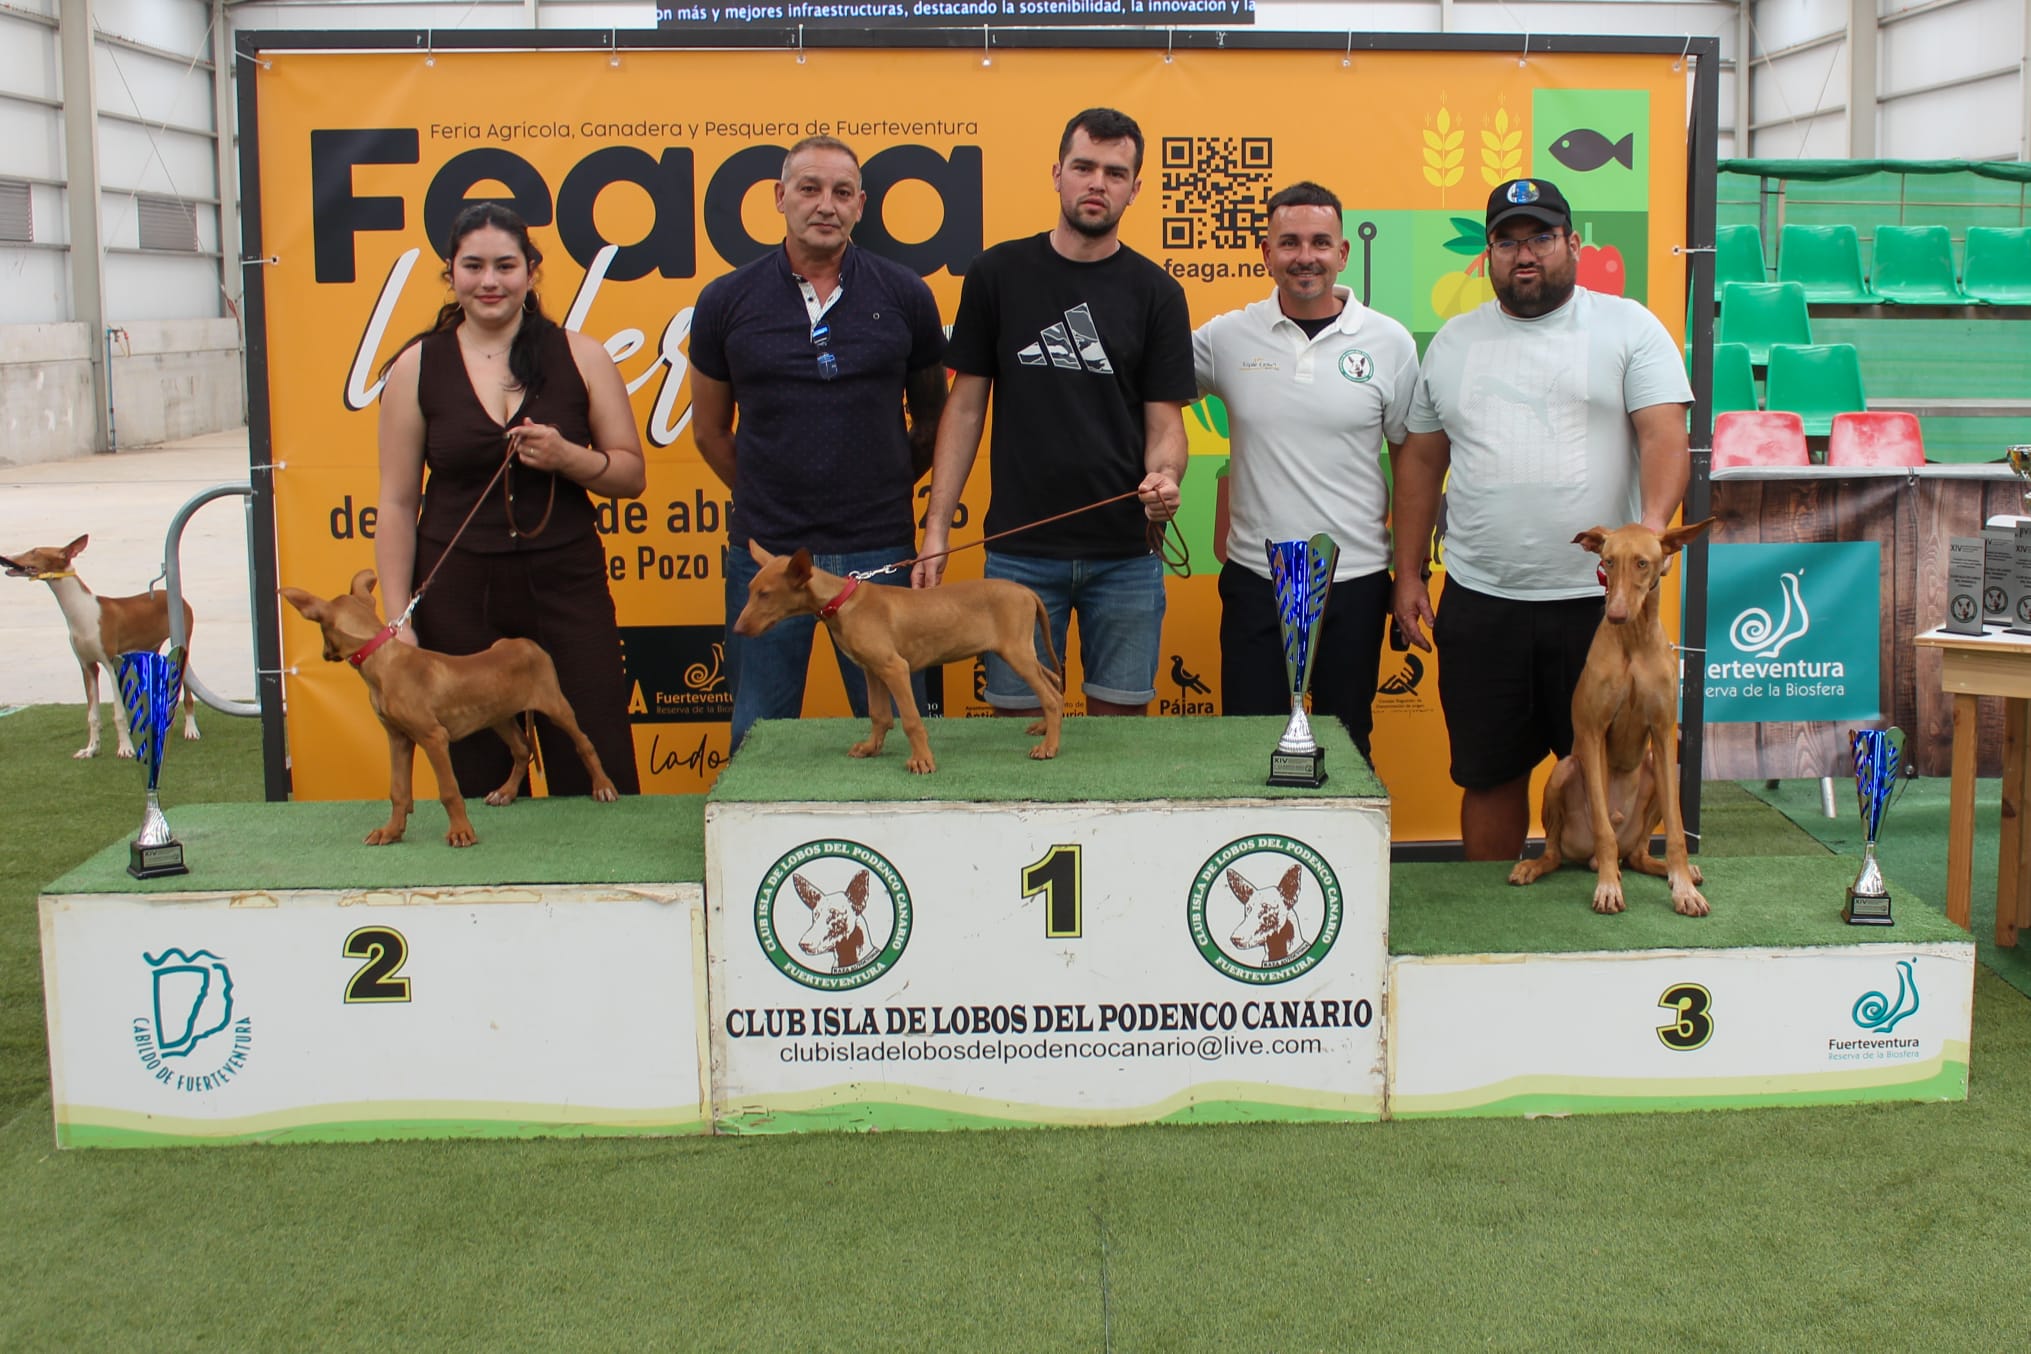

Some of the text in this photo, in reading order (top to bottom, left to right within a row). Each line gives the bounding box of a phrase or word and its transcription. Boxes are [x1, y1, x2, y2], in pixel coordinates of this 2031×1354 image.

[678, 4, 707, 20] más
[712, 8, 720, 22] y
[725, 4, 783, 22] mejores
[788, 2, 909, 18] infraestructuras,
[913, 0, 997, 15] destacando
[1002, 0, 1015, 14] la
[1019, 0, 1126, 14] sostenibilidad,
[1131, 0, 1144, 12] la
[1231, 0, 1242, 13] y
[430, 120, 978, 141] Feria Agrícola, Ganadera y Pesquera de Fuerteventura
[329, 495, 378, 540] de
[596, 497, 648, 535] de
[638, 546, 709, 580] Pozo
[1743, 684, 1763, 697] de
[1768, 683, 1780, 697] la
[1786, 682, 1845, 697] Biosfera
[1160, 699, 1214, 715] Pájara
[759, 843, 909, 951] CLUB ISLA DE LOBOS DEL PODENCO CANARIO
[1021, 844, 1082, 938] 1
[1192, 838, 1339, 946] CLUB ISLA DE LOBOS DEL PODENCO CANARIO
[343, 925, 412, 1004] 2
[784, 961, 886, 987] FUERTEVENTURA
[1215, 956, 1316, 982] FUERTEVENTURA
[725, 999, 1373, 1038] CLUB ISLA DE LOBOS DEL PODENCO CANARIO
[1656, 983, 1714, 1051] 3
[133, 1016, 252, 1092] CABILDO DE FUERTEVENTURA
[780, 1035, 1321, 1064] clubisladelobosdelpodencocanario@live.com
[1829, 1038, 1919, 1050] Fuerteventura
[1829, 1050, 1919, 1060] Reserva de la Biosfera
